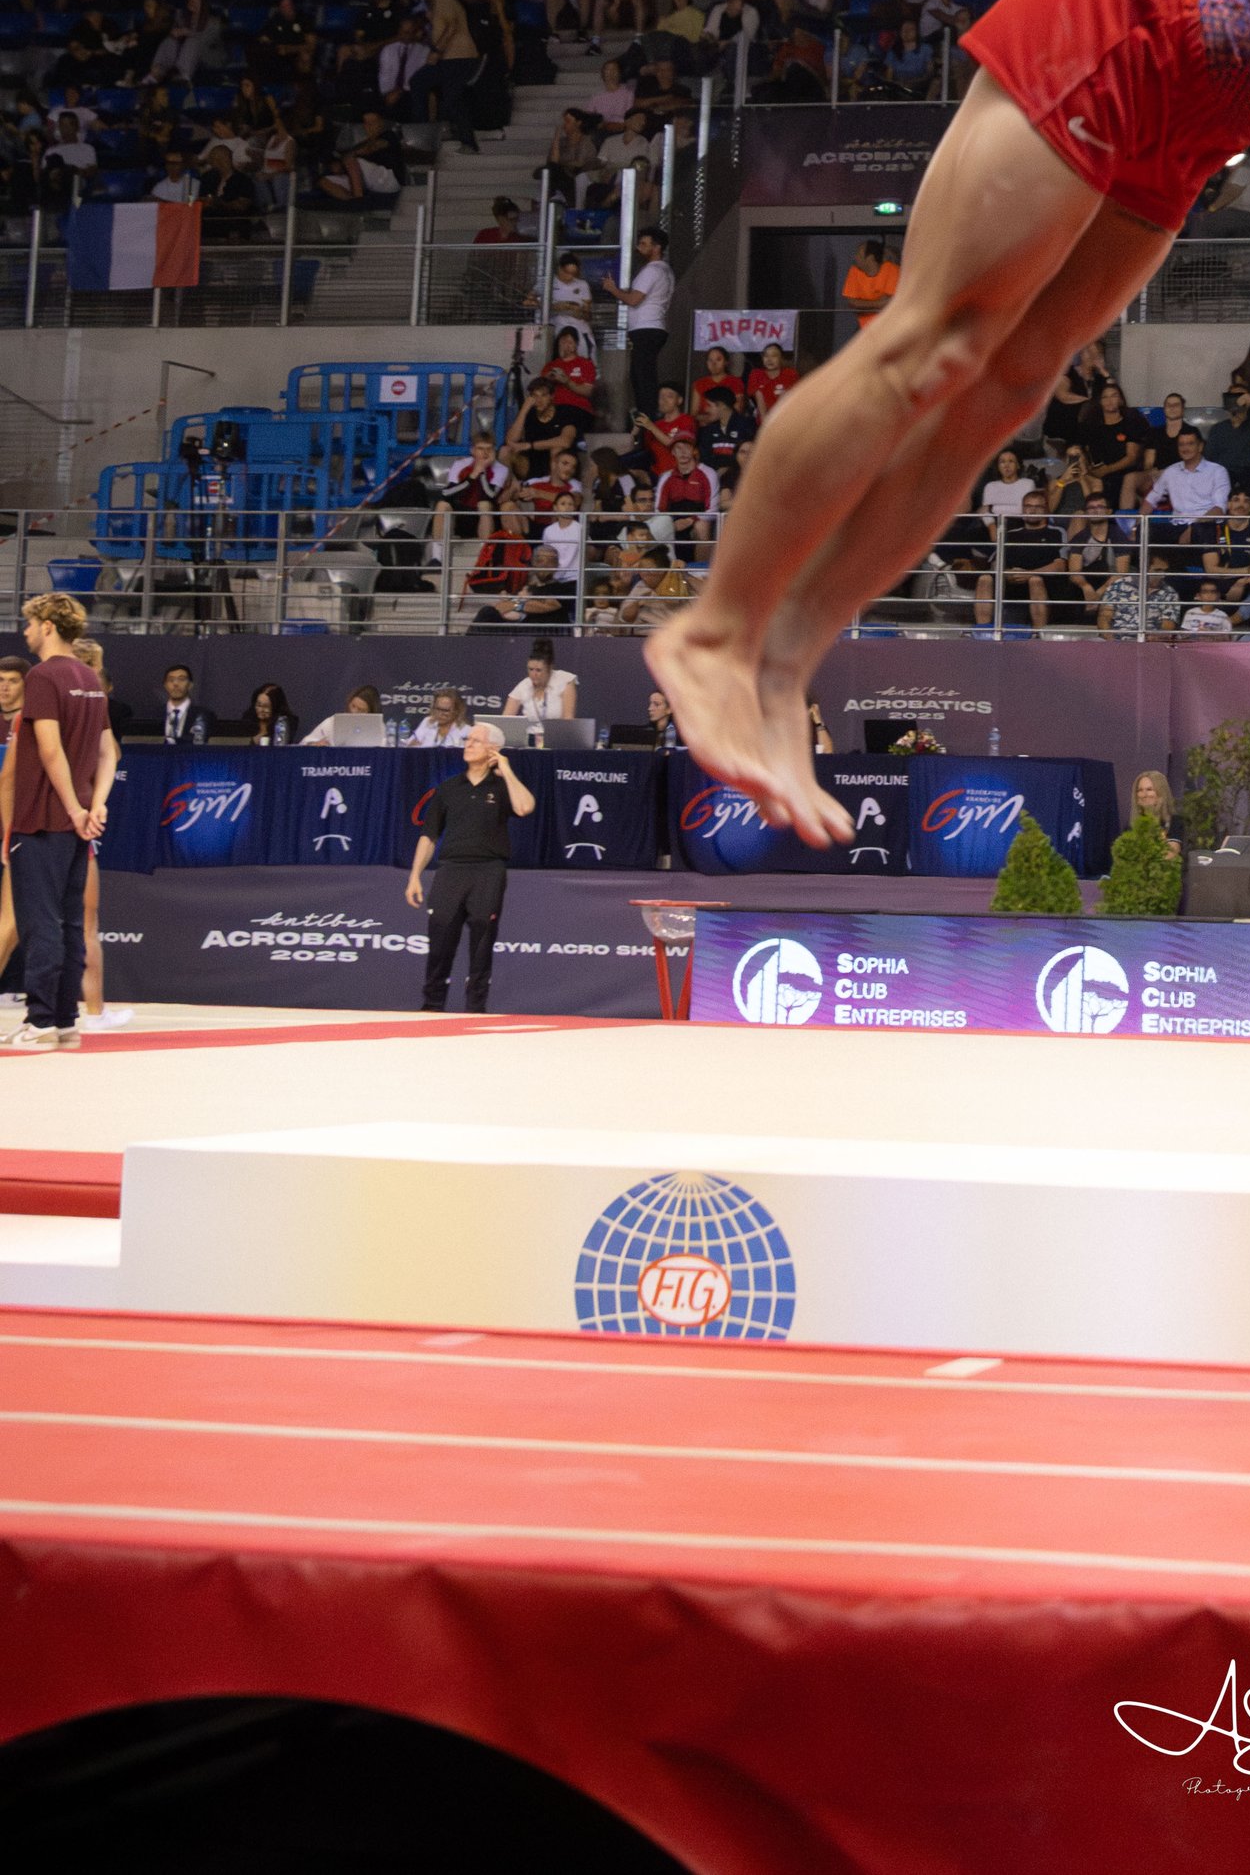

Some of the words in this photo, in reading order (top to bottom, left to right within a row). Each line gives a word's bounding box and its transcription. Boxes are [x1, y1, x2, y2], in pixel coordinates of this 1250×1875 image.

[705, 318, 784, 342] JAPAN
[843, 699, 993, 714] ACROBATICS
[888, 711, 946, 720] 2025
[301, 765, 372, 777] TRAMPOLINE
[556, 769, 629, 783] TRAMPOLINE
[834, 774, 910, 786] TRAMPOLINE
[201, 930, 431, 954] ACROBATICS
[547, 943, 610, 955] ACRO
[269, 949, 360, 963] 2025
